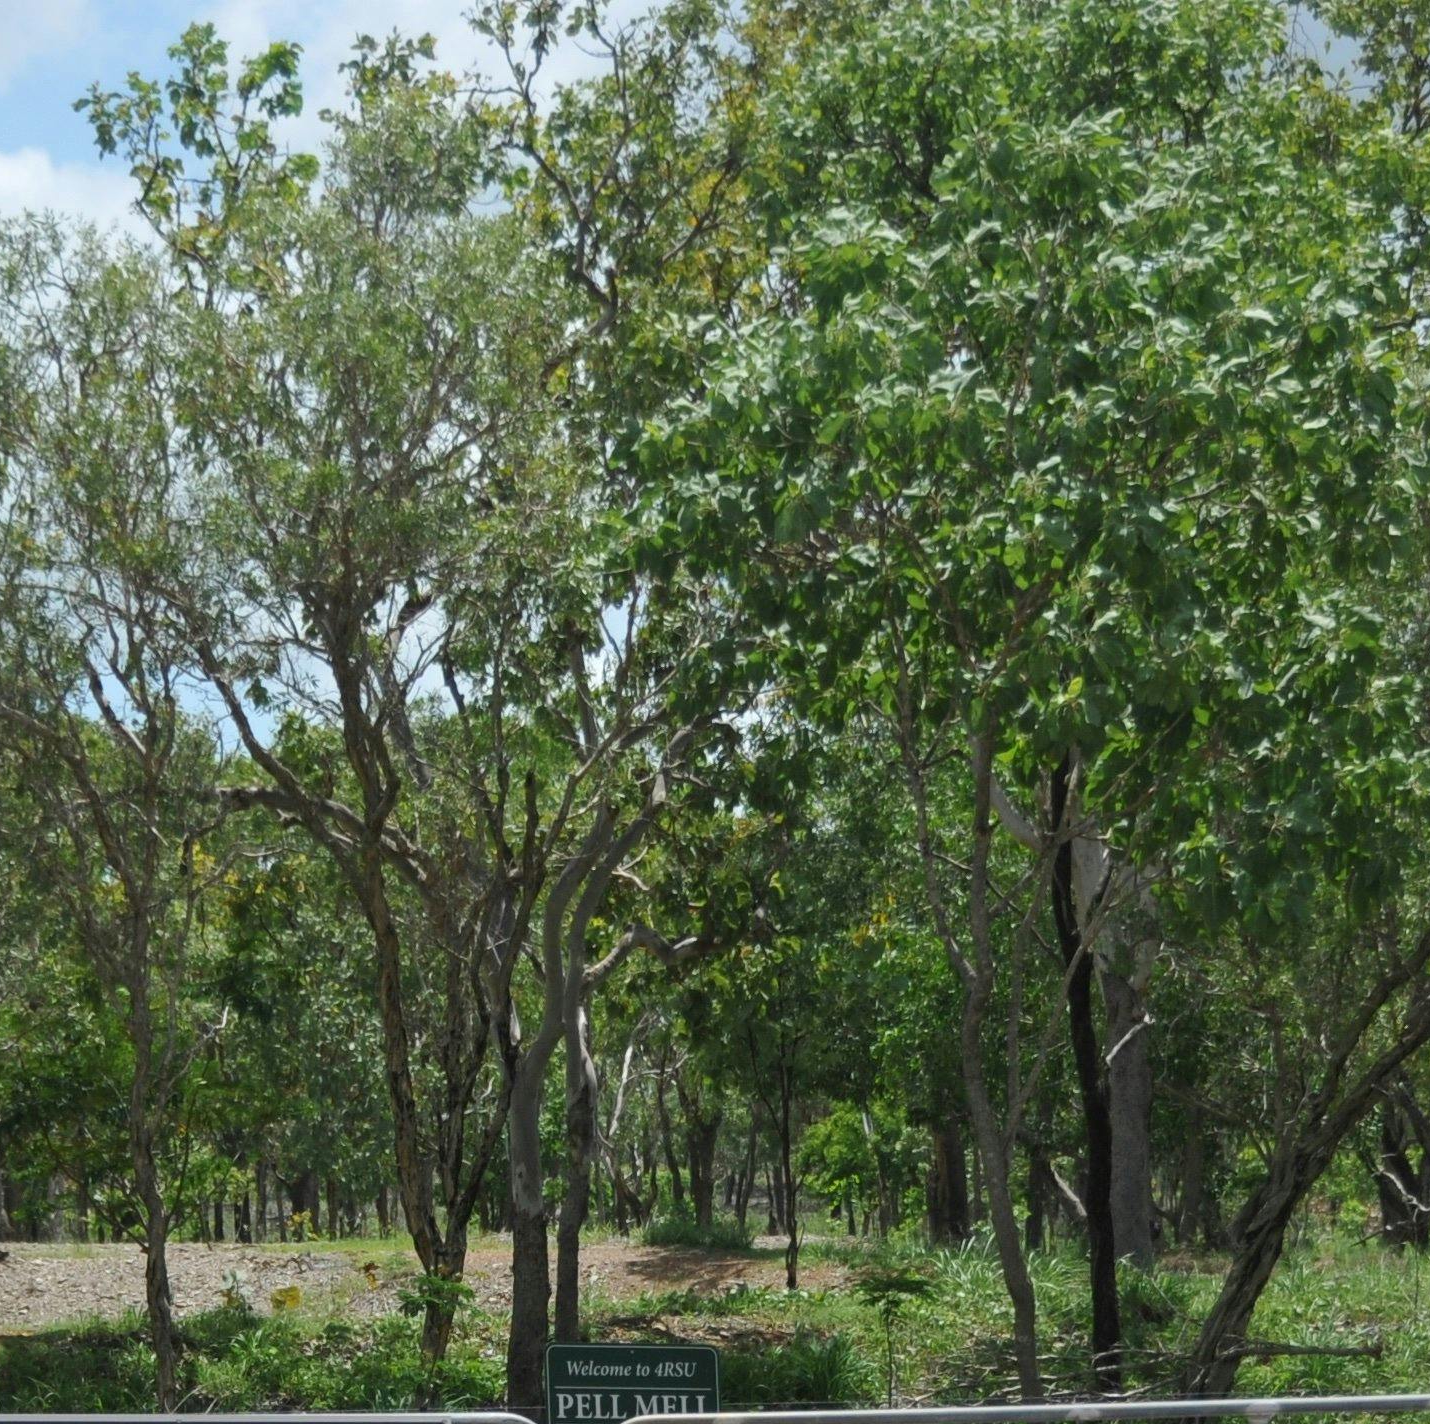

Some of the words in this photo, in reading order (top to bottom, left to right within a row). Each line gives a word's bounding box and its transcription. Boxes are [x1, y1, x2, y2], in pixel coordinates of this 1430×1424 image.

[567, 1360, 632, 1377] Welcome
[636, 1362, 650, 1377] to
[654, 1361, 697, 1378] 4RSU
[556, 1393, 627, 1419] PELL
